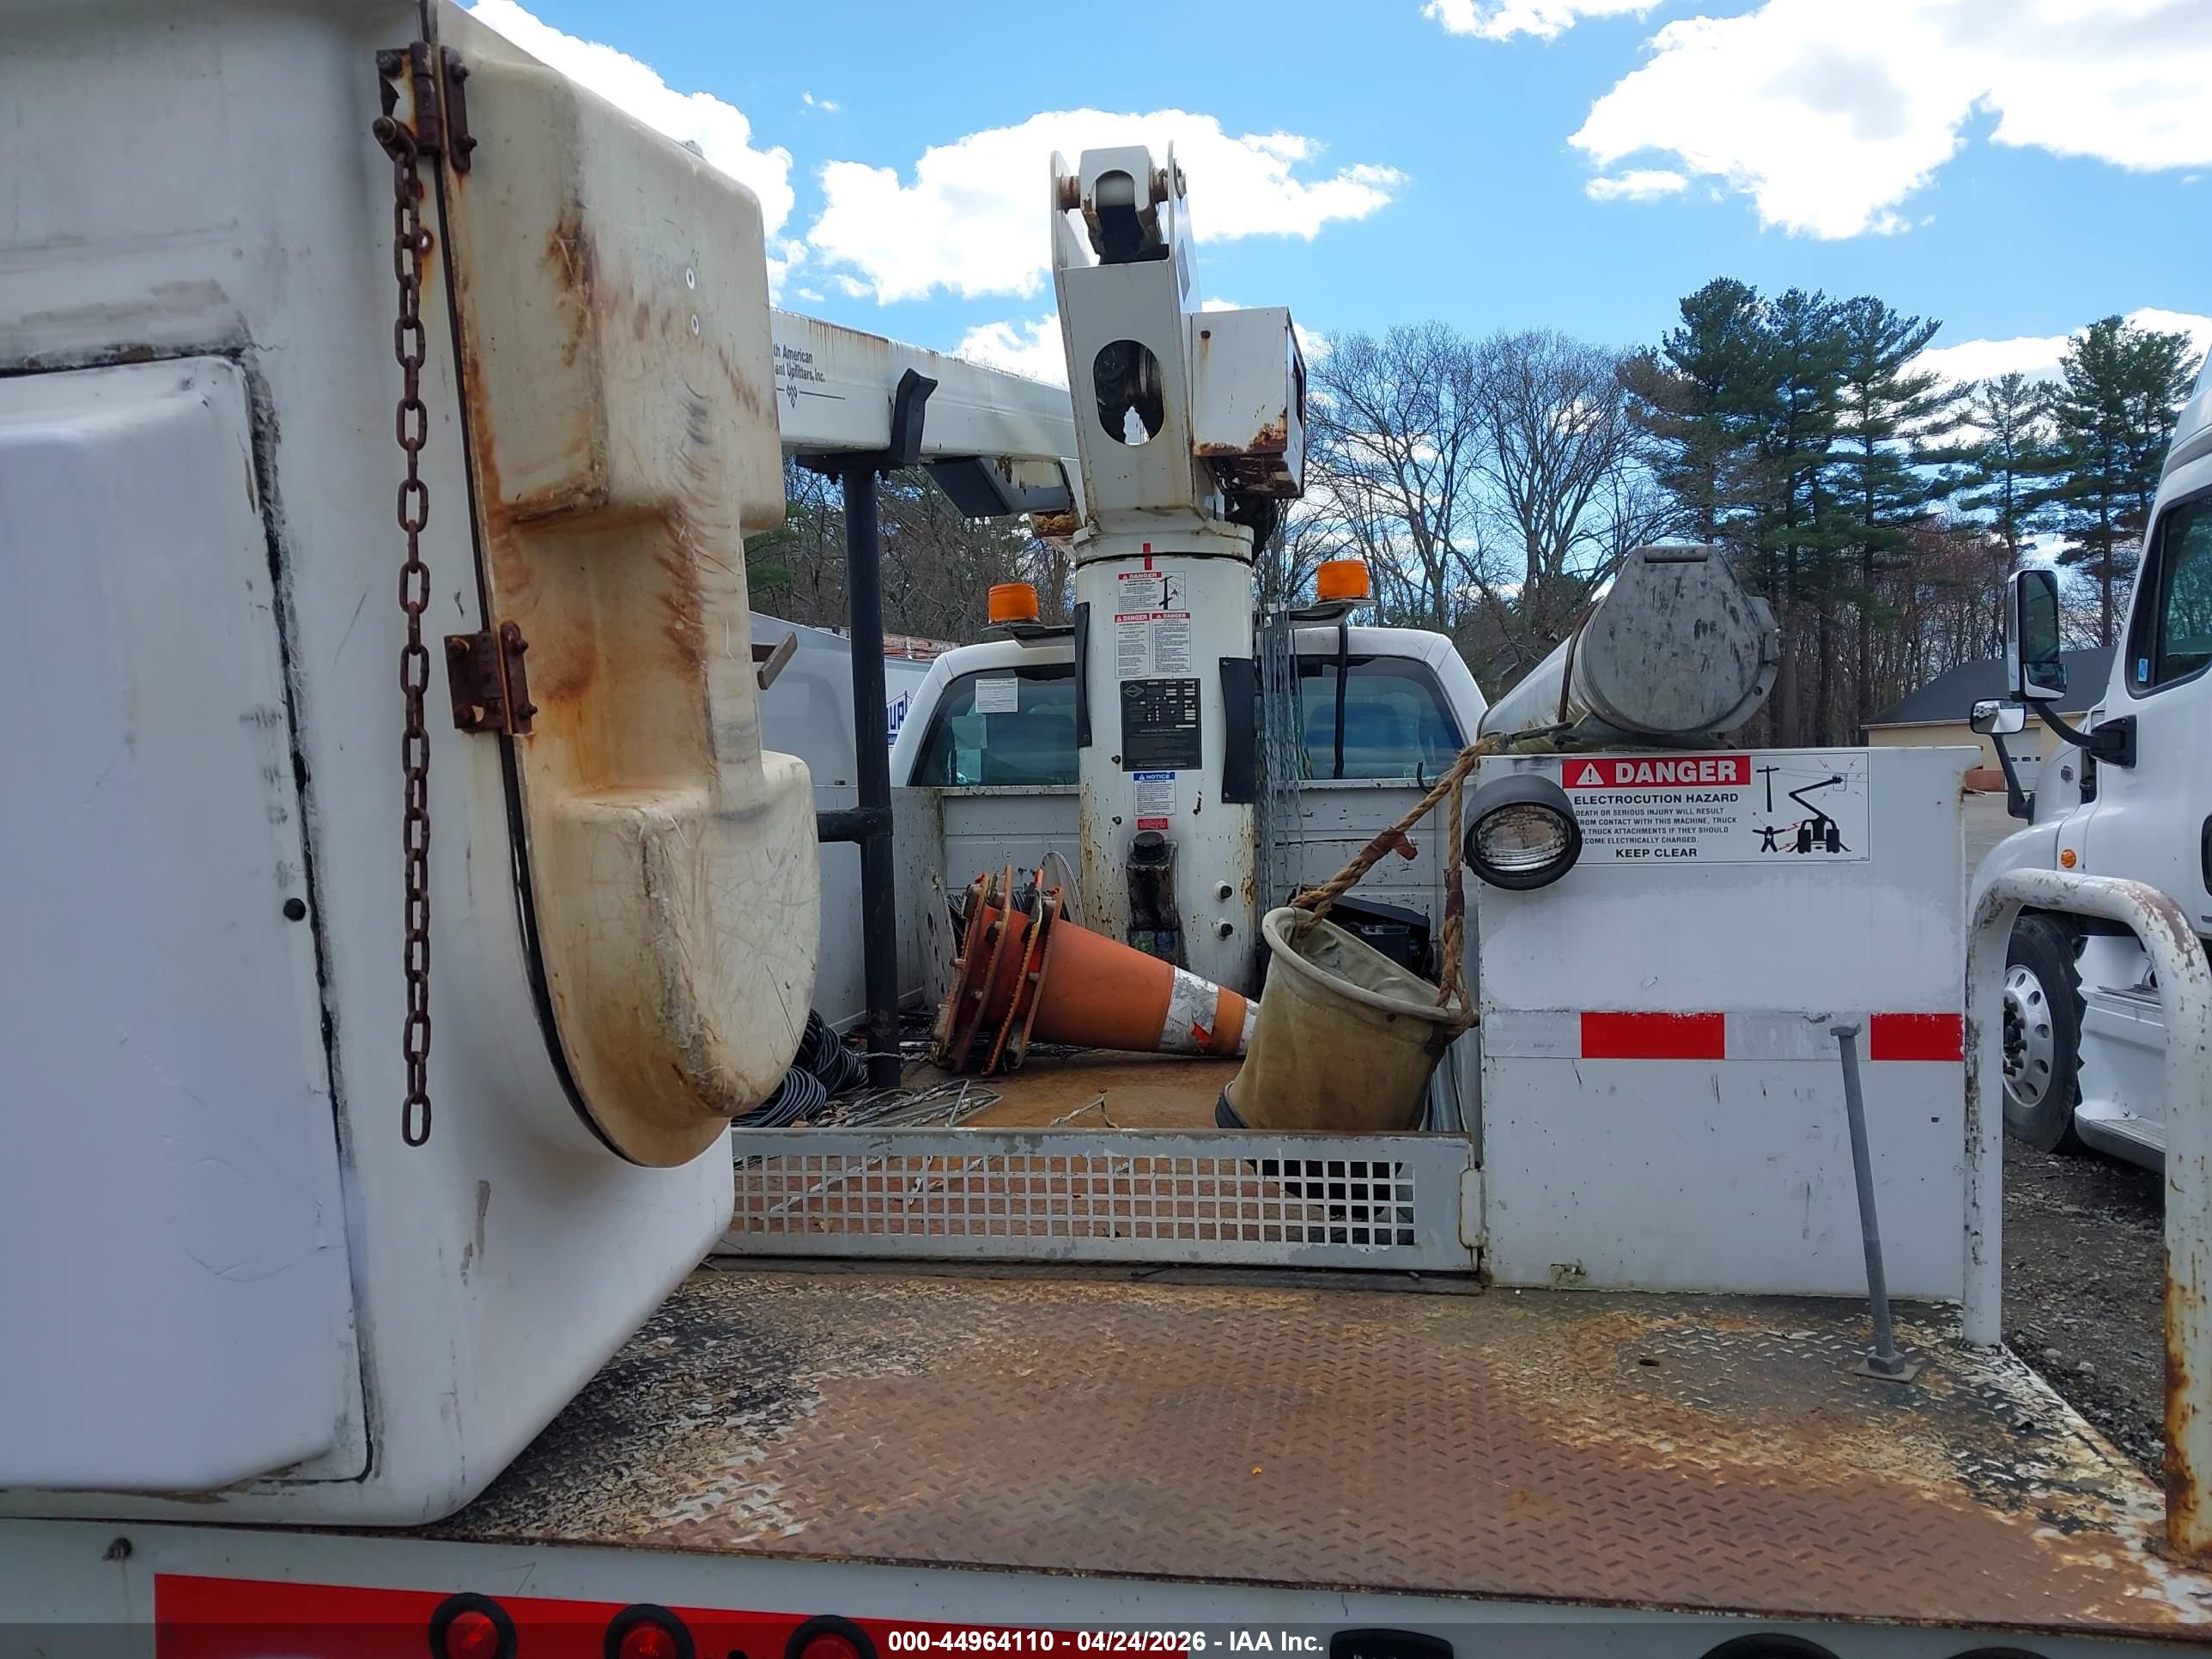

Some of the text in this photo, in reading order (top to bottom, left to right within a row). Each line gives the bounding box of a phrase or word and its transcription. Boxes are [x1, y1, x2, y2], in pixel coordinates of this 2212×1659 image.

[782, 343, 813, 365] American
[786, 360, 815, 385] Upfitters,
[814, 367, 826, 383] Inc.
[1615, 760, 1737, 784] DANGER
[1574, 793, 1740, 805] ELECTROCUTION HAZARD
[1613, 808, 1645, 817] SERIOUS
[1675, 807, 1695, 816] WILL
[1674, 817, 1711, 825] MACHINE,
[1613, 827, 1667, 836] ATTACHMENTS
[1678, 826, 1697, 835] THEY
[1661, 836, 1700, 844] CHARGED.
[1615, 848, 1698, 858] KEEP CLEAR
